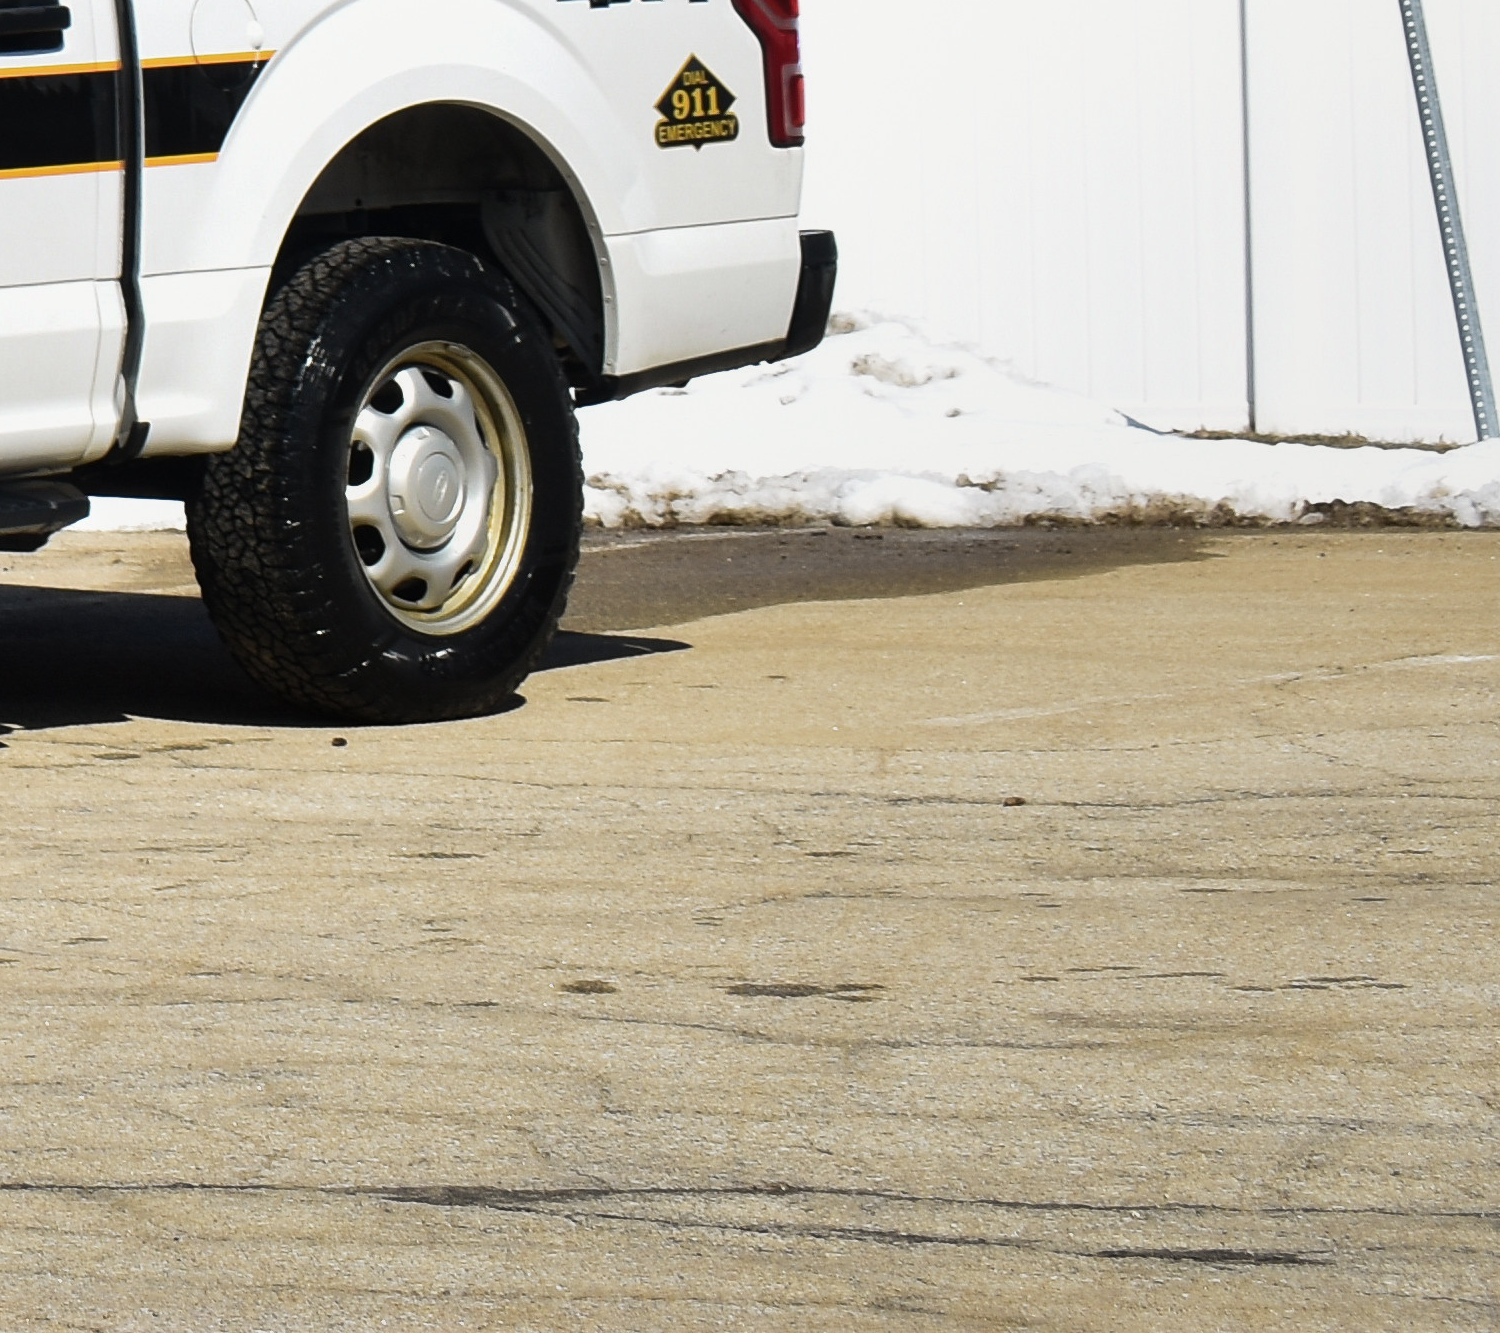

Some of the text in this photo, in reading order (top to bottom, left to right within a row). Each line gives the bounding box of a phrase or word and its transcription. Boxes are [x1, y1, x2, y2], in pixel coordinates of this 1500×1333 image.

[683, 70, 709, 86] DIAL
[672, 85, 720, 120] 911
[659, 119, 736, 143] EMERGENCY
